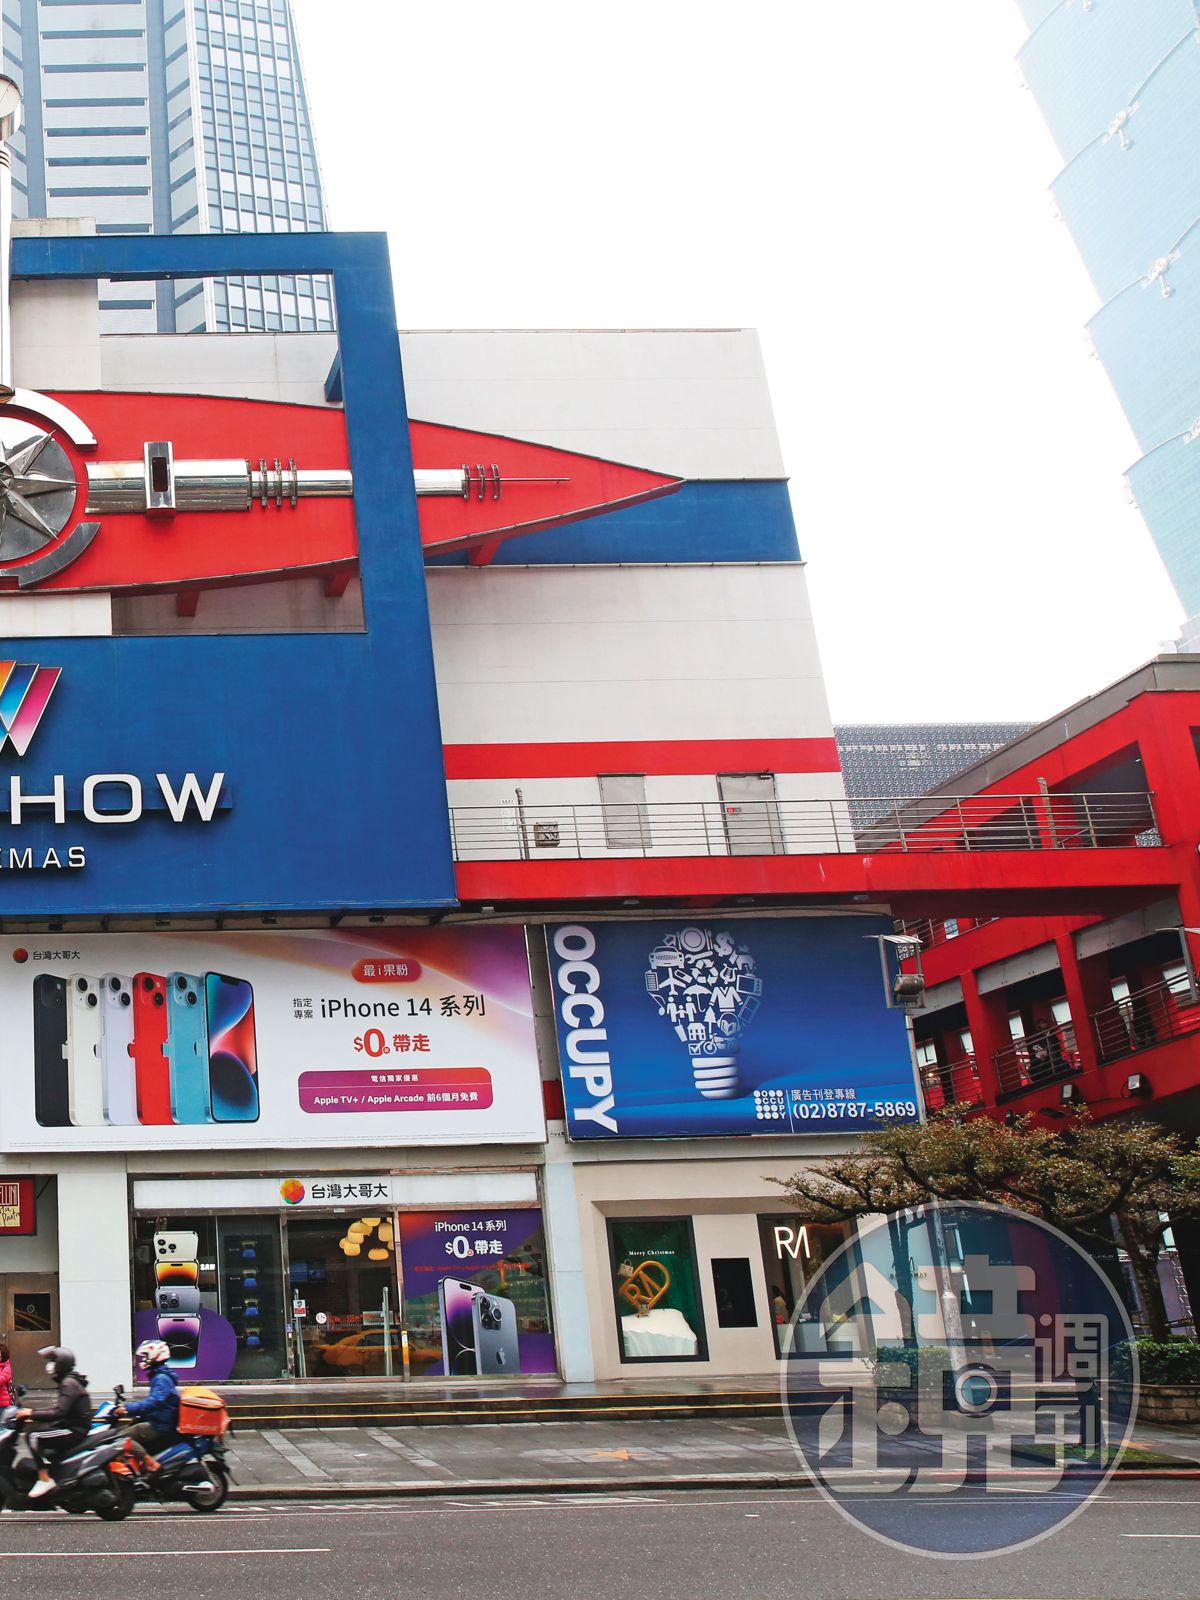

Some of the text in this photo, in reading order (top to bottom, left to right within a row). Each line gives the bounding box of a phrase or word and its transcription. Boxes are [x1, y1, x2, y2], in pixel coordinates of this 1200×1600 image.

[33, 950, 80, 960] 台灣大哥大
[321, 994, 486, 1018] iPhone 14 系列
[554, 925, 618, 1133] OCCUPY
[392, 1034, 431, 1053] 帶走
[314, 1096, 339, 1105] Apple
[340, 1096, 359, 1104] TV+
[368, 1094, 392, 1105] Apple
[394, 1094, 424, 1102] Arcade
[791, 1088, 856, 1101] 廣告刊登專線
[793, 1101, 916, 1119] (02)8787-5869
[311, 1183, 388, 1199] 台灣大哥大
[435, 1220, 507, 1232] iPhone 14 系列
[474, 1239, 504, 1255] 帶走
